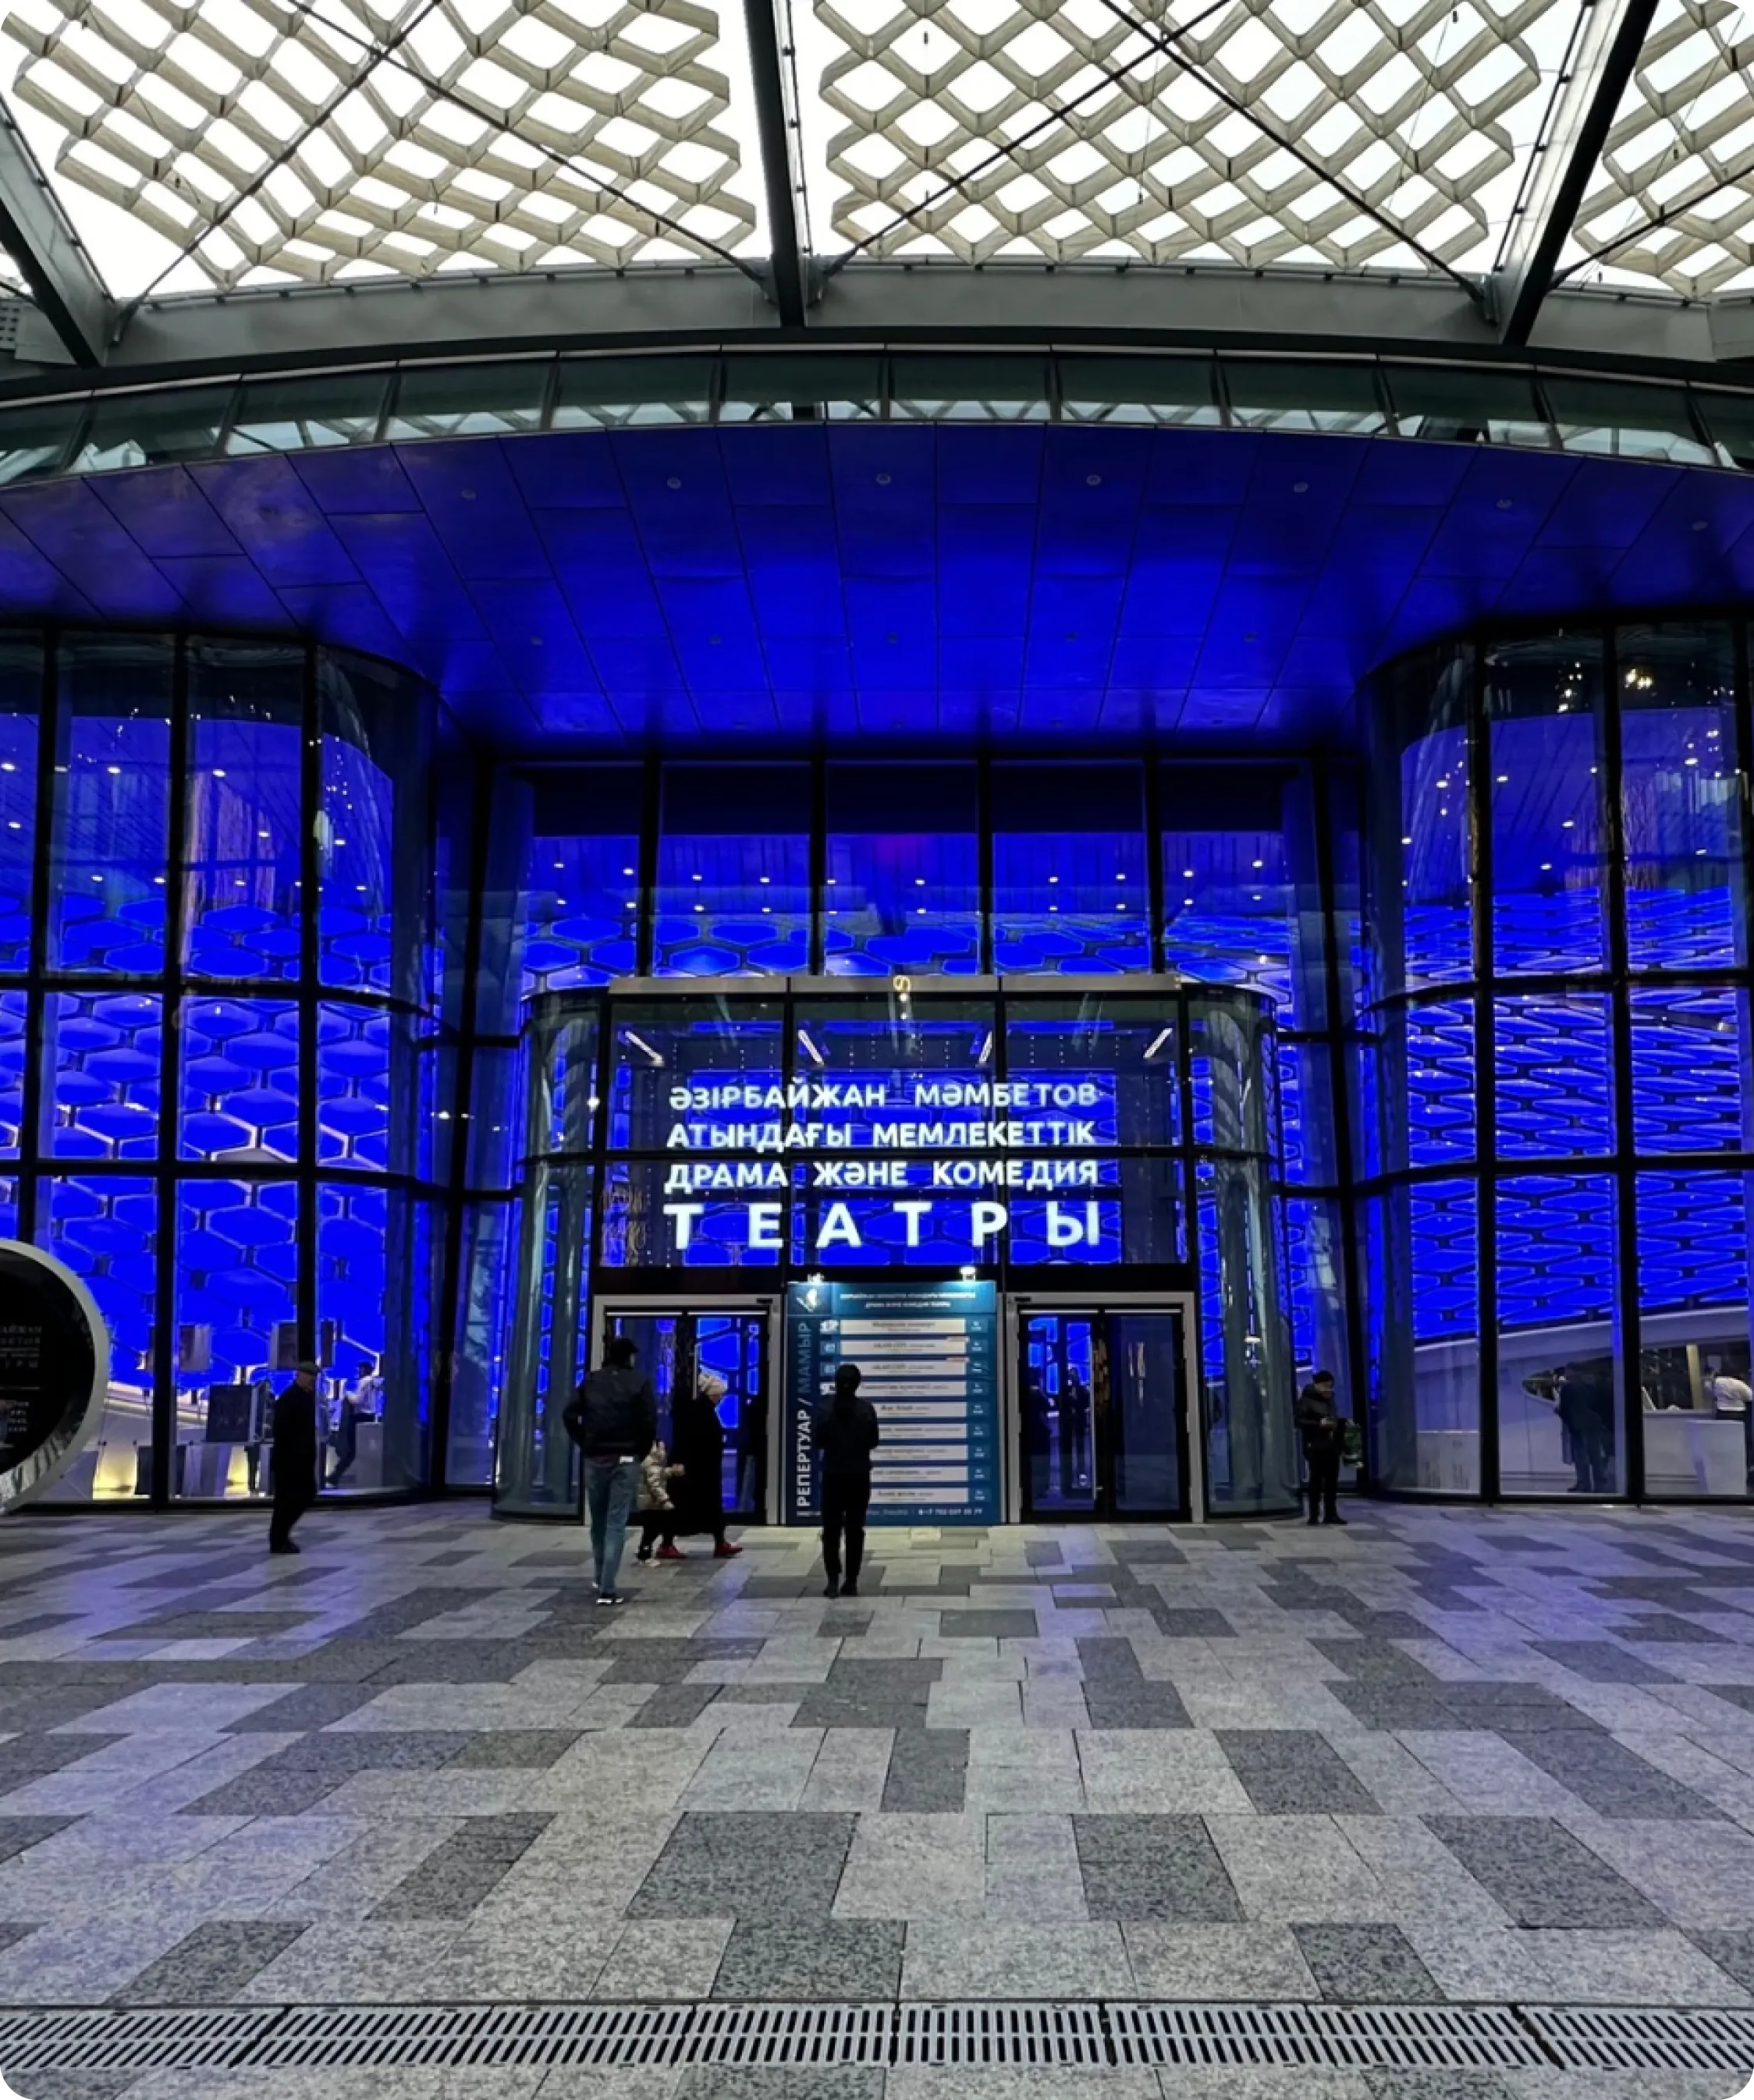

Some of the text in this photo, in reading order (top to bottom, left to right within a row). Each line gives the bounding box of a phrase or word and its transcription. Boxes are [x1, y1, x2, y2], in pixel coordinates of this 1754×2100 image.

[669, 1077, 1098, 1110] ӘЗІРБАЙЖАН МӘМБЕТОВ
[666, 1121, 1095, 1153] АТЫНДАҒЫ МЕМЛЕКЕТТІК
[663, 1160, 1099, 1194] ДРАМА ЖӘНЕ КОМЕДИЯ
[663, 1201, 1100, 1250] ТЕАТРЫ
[797, 1321, 813, 1393] МАМЫР
[796, 1409, 812, 1507] РЕПЕРТУАР
